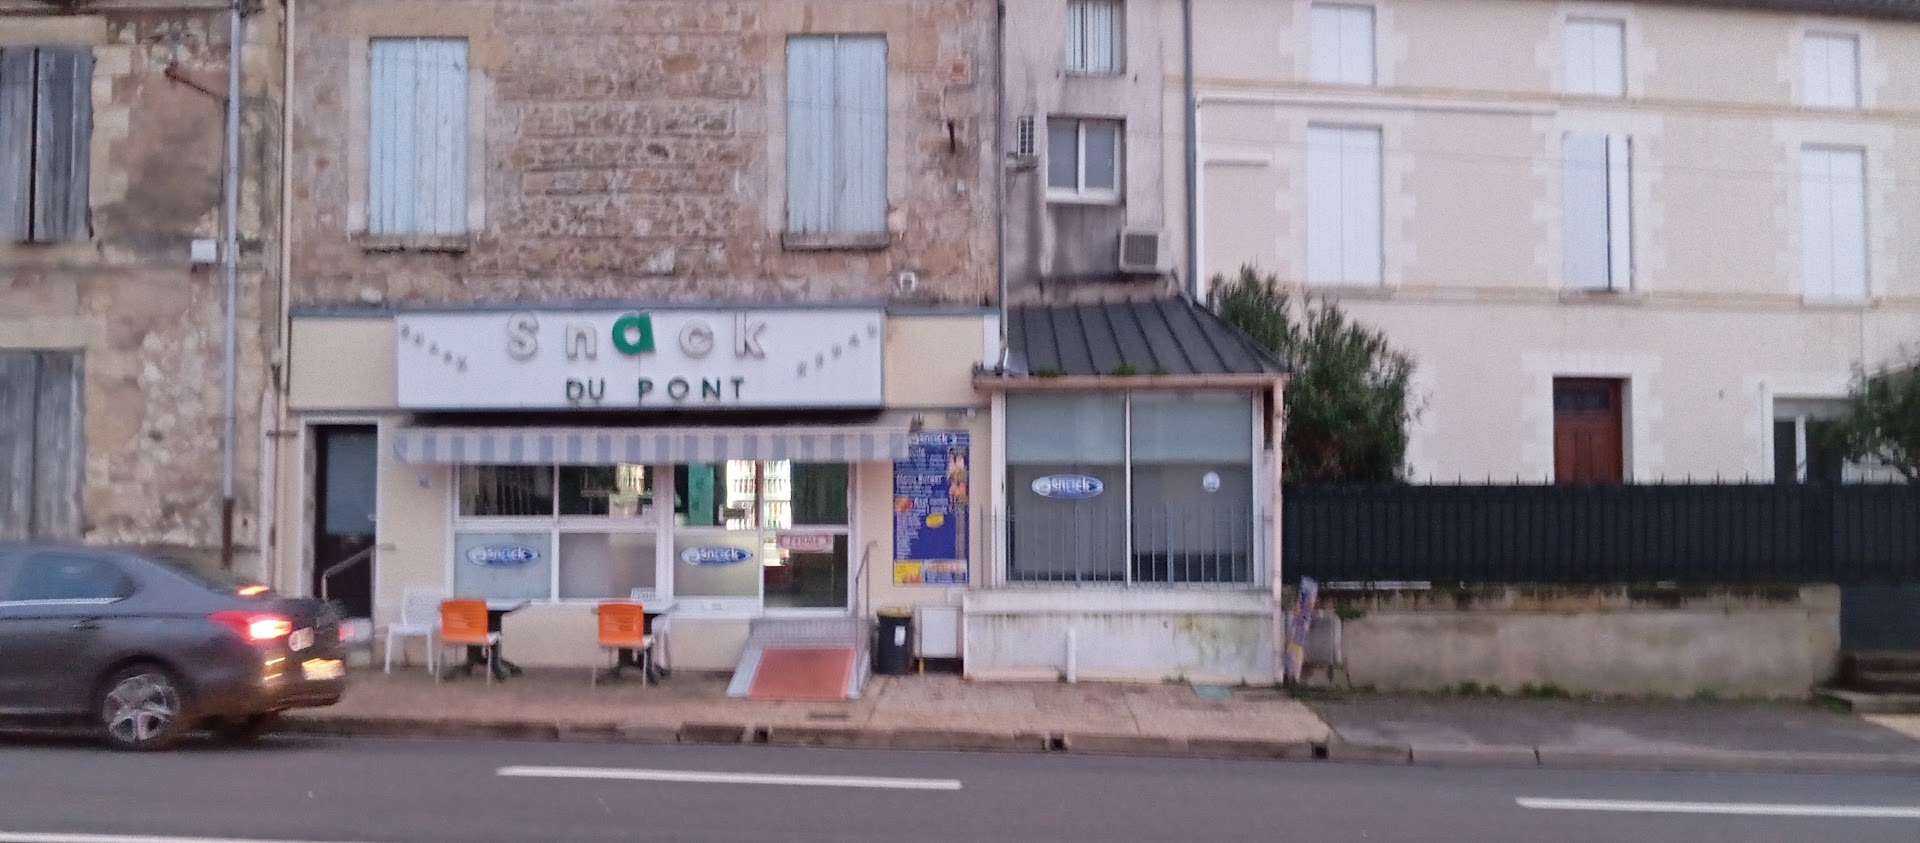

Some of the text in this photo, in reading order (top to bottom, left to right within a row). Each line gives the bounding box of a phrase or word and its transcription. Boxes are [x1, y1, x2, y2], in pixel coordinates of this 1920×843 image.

[506, 311, 766, 362] Snack
[566, 376, 745, 402] DU PONT
